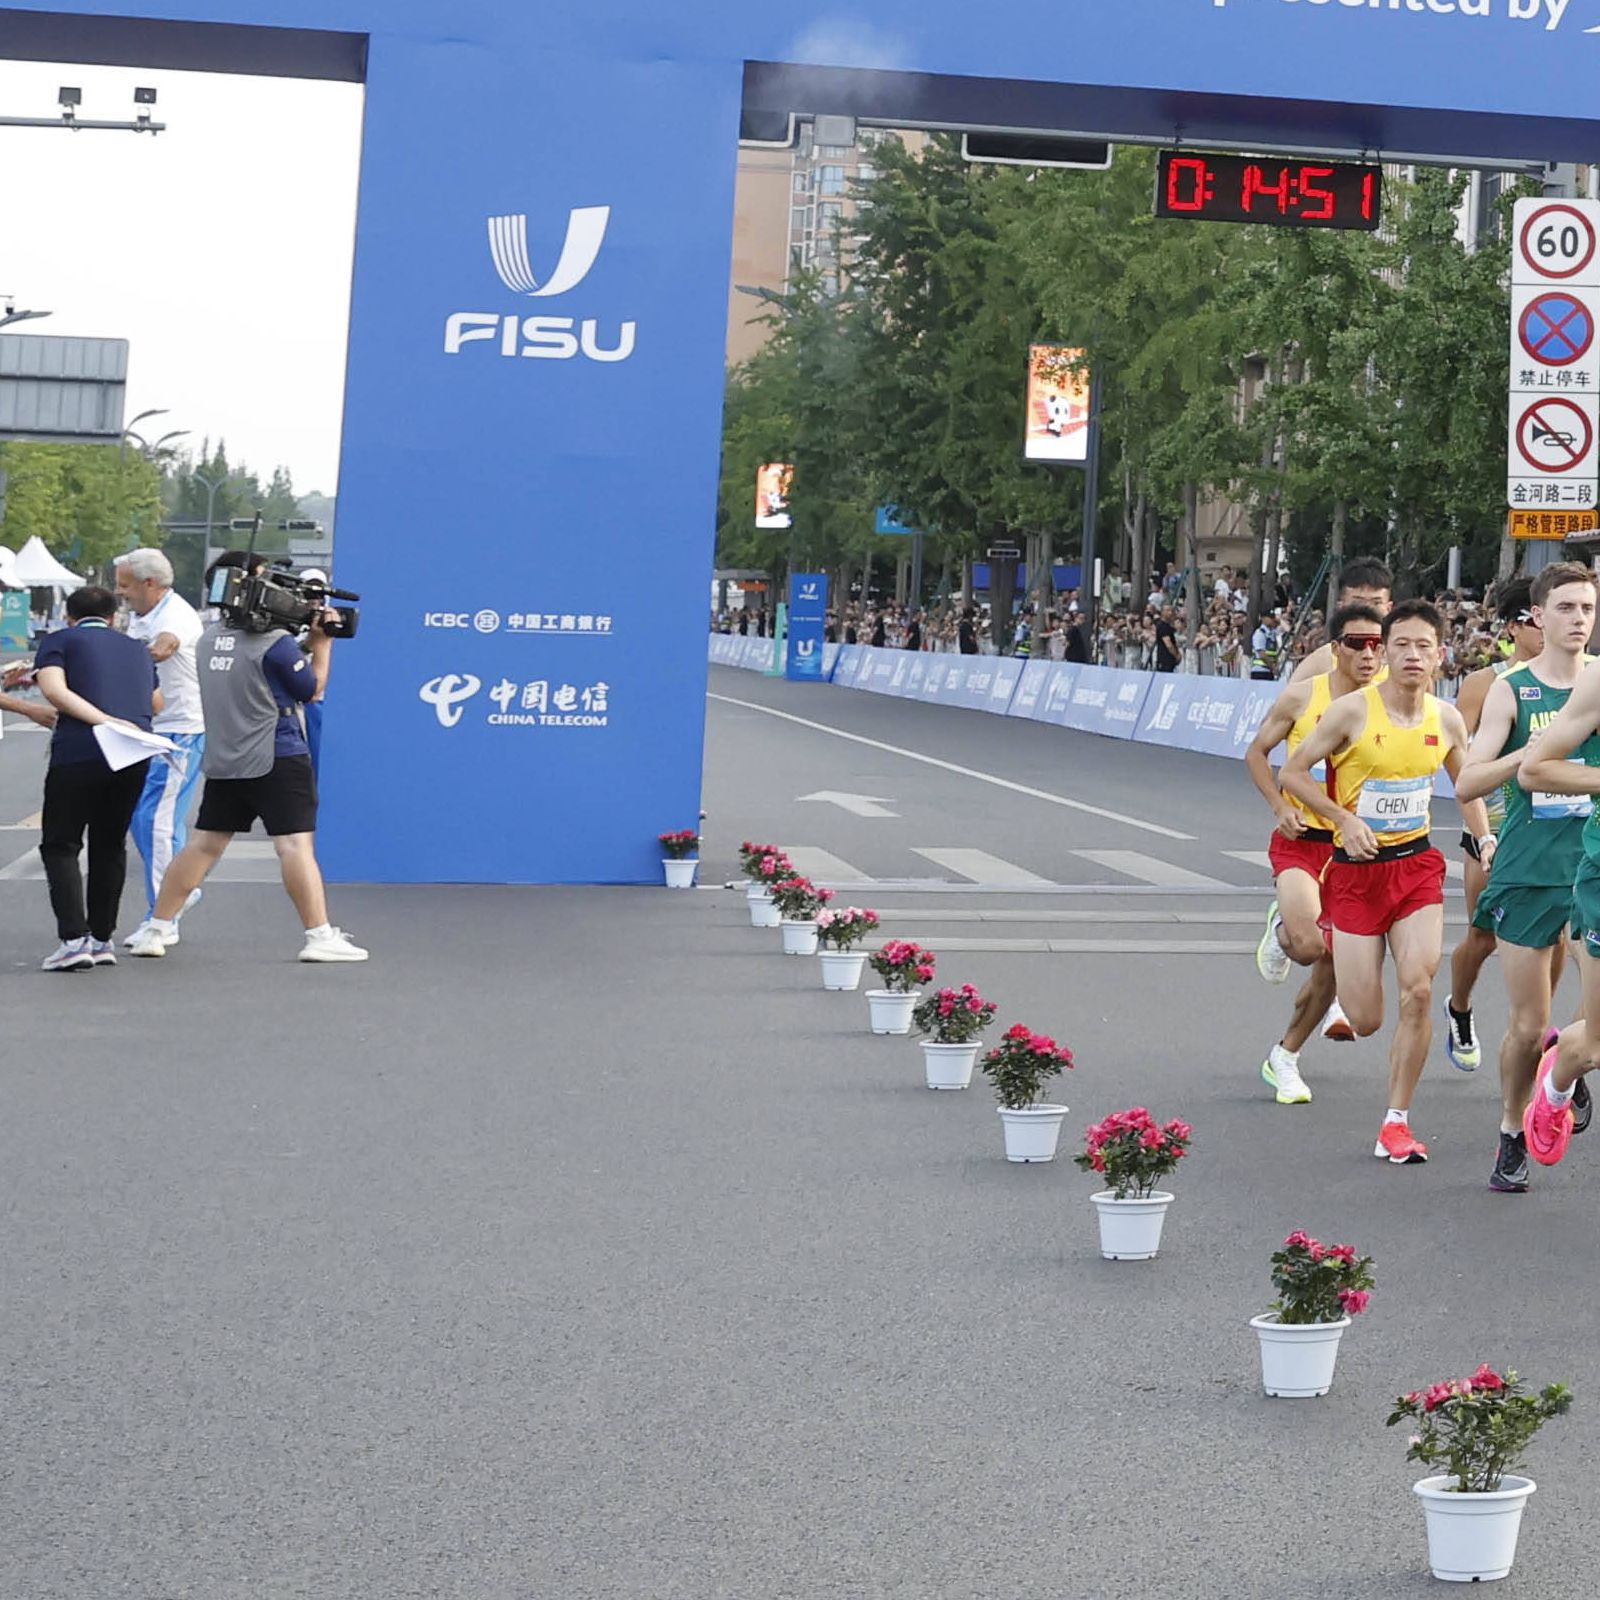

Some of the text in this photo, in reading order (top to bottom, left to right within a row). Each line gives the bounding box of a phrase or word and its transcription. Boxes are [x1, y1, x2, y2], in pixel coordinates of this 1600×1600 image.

[1537, 225, 1579, 258] 60
[444, 312, 636, 362] FISU
[1519, 368, 1591, 387] 禁止停车
[1513, 483, 1592, 504] 金河路二段
[1512, 513, 1594, 535] 严格管理路段
[424, 612, 469, 628] ICBC
[507, 613, 612, 631] 中国工商银行
[214, 637, 235, 651] HB
[489, 677, 610, 714] 中国电信
[488, 713, 607, 726] CHINA TELECOM
[1376, 798, 1409, 814] CHEN
